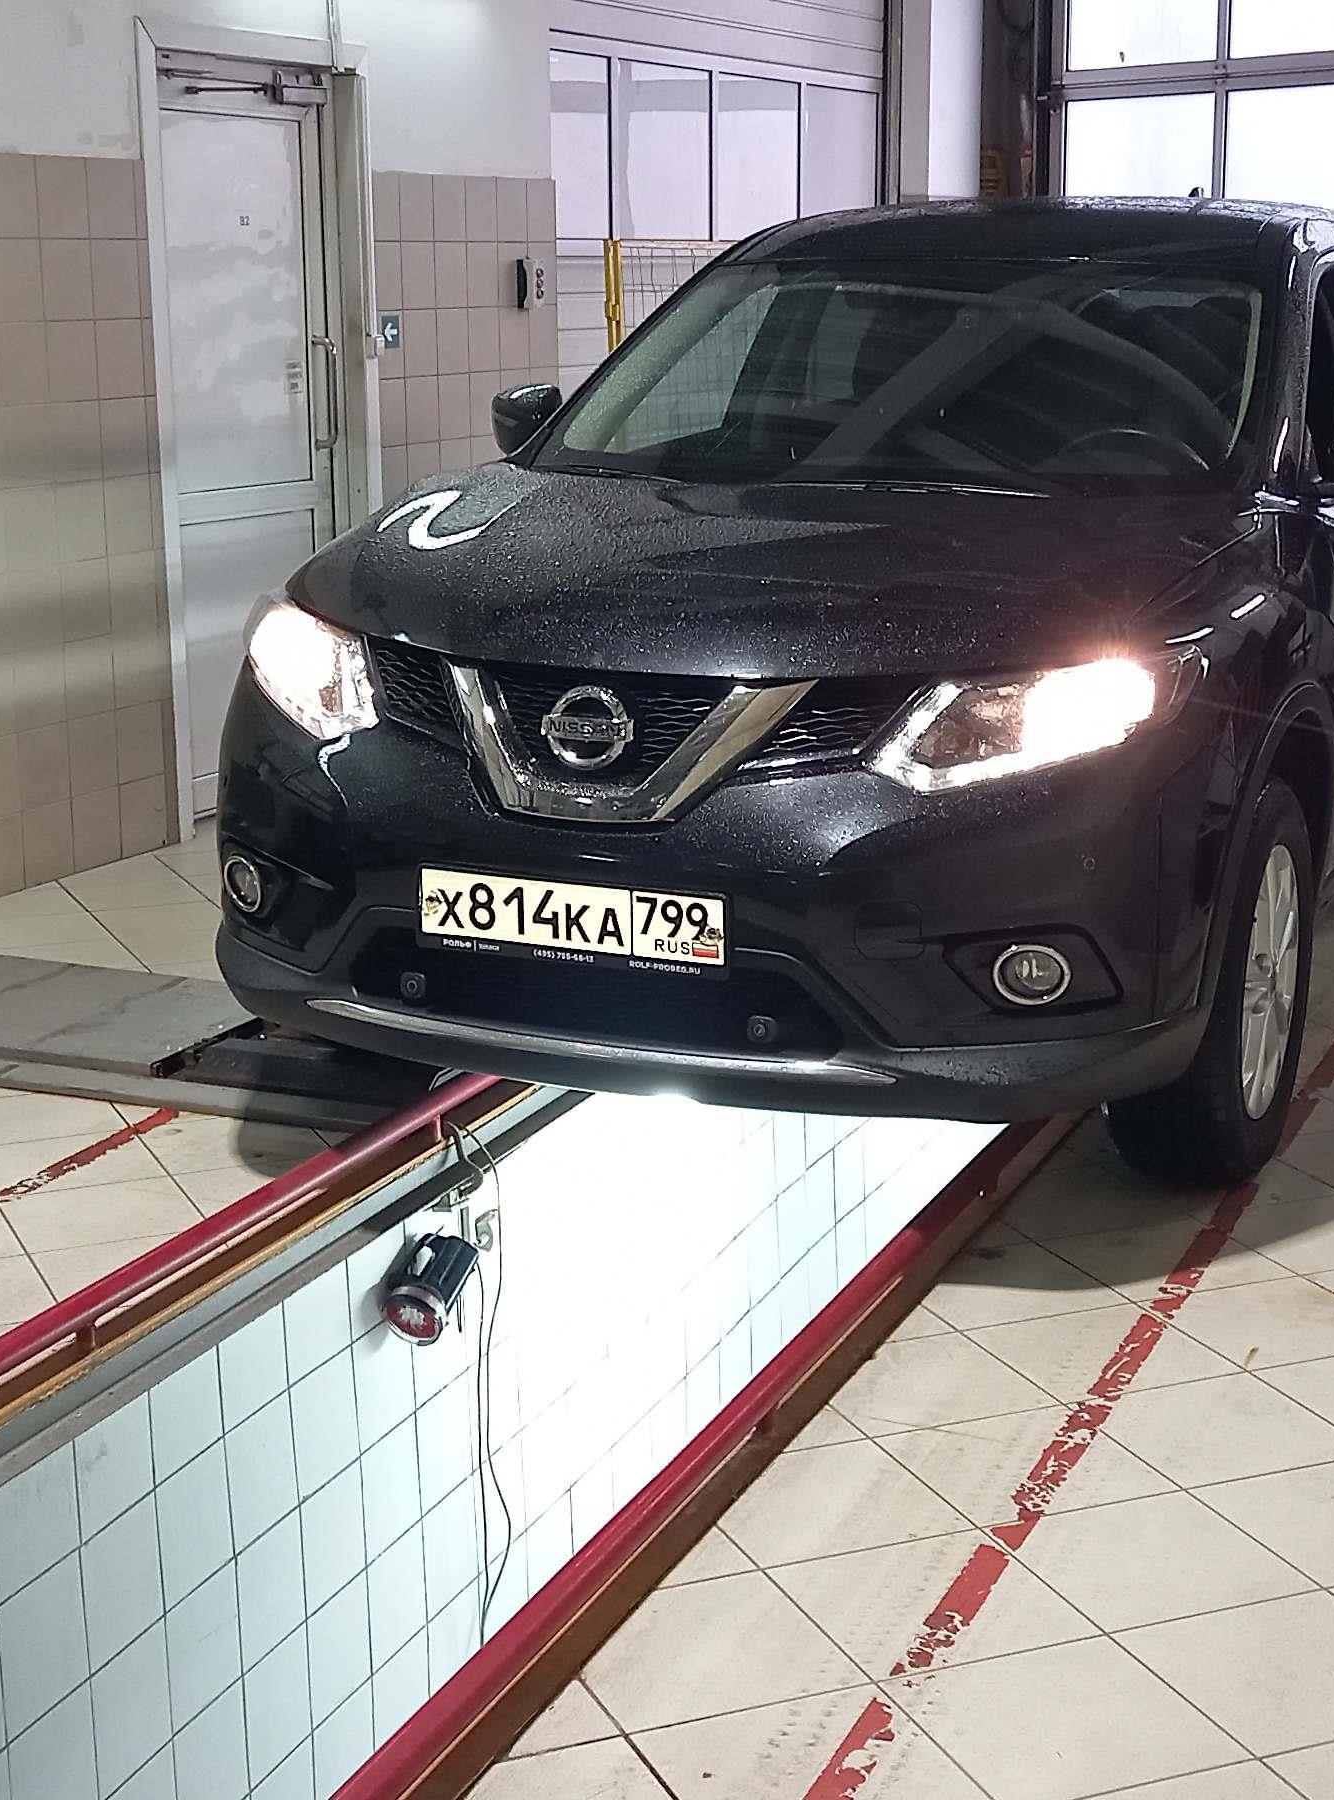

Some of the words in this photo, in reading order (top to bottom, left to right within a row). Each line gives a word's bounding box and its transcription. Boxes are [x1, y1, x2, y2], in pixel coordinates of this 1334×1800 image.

[438, 882, 624, 947] Х814КА
[636, 896, 709, 941] 799
[442, 938, 472, 949] РОЛЬФ
[655, 938, 690, 955] RUS
